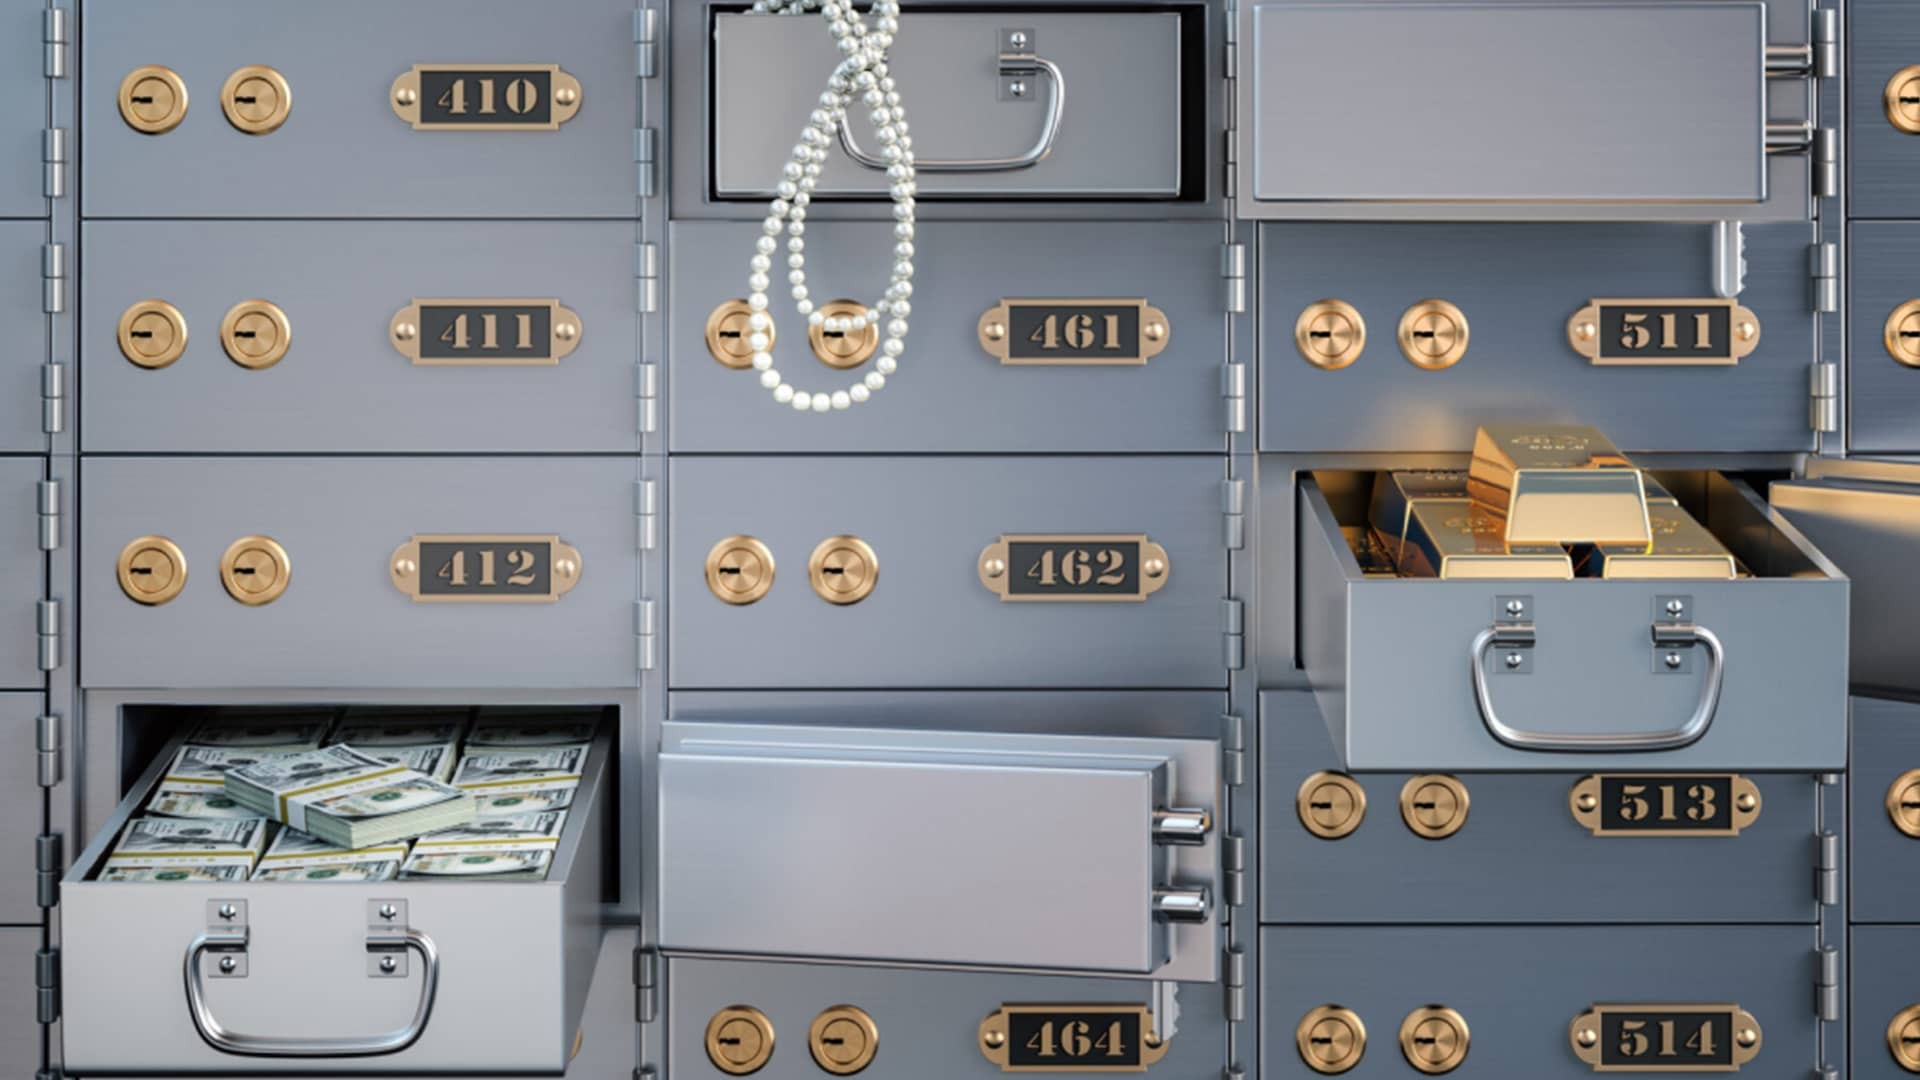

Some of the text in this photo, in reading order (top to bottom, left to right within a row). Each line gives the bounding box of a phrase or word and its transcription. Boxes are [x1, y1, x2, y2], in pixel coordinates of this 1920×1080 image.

[439, 80, 536, 113] 410
[441, 315, 532, 347] 411
[1031, 315, 1121, 347] 461
[1622, 314, 1712, 347] 511
[440, 551, 535, 584] 412
[1028, 550, 1124, 584] 462
[1621, 786, 1715, 820] 513
[1027, 1022, 1124, 1055] 464
[1621, 1021, 1715, 1055] 514
